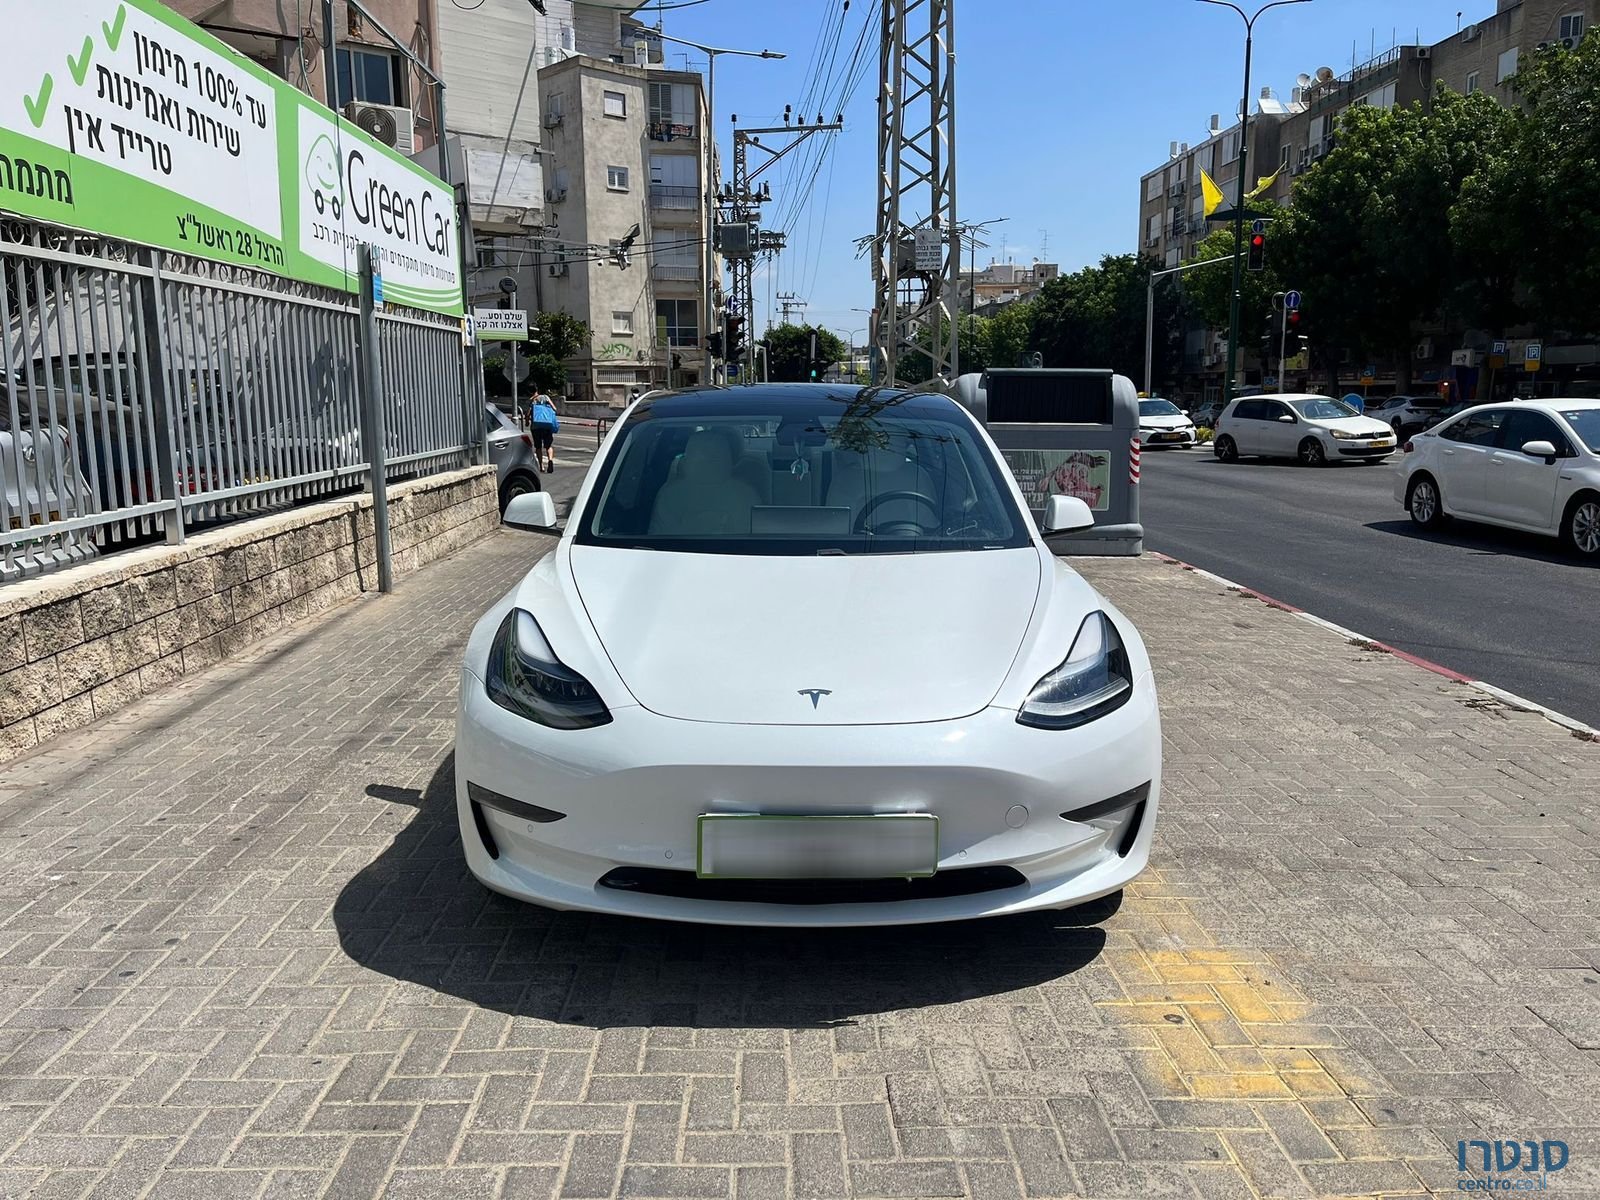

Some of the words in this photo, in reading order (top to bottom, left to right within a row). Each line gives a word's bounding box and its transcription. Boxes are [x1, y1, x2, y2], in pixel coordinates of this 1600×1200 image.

[133, 30, 188, 89] מימון
[96, 63, 182, 132] ואמינות
[193, 61, 243, 117] 100%
[245, 94, 267, 130] עד
[64, 105, 105, 154] אין
[110, 122, 172, 175] טרייד
[186, 106, 241, 157] שירות
[347, 150, 419, 245] Green
[421, 190, 451, 258] Car
[235, 228, 254, 258] 28
[254, 231, 285, 266] הרצל
[312, 222, 331, 242] רכב
[500, 321, 523, 329] אצלנו
[504, 310, 523, 320] שלם
